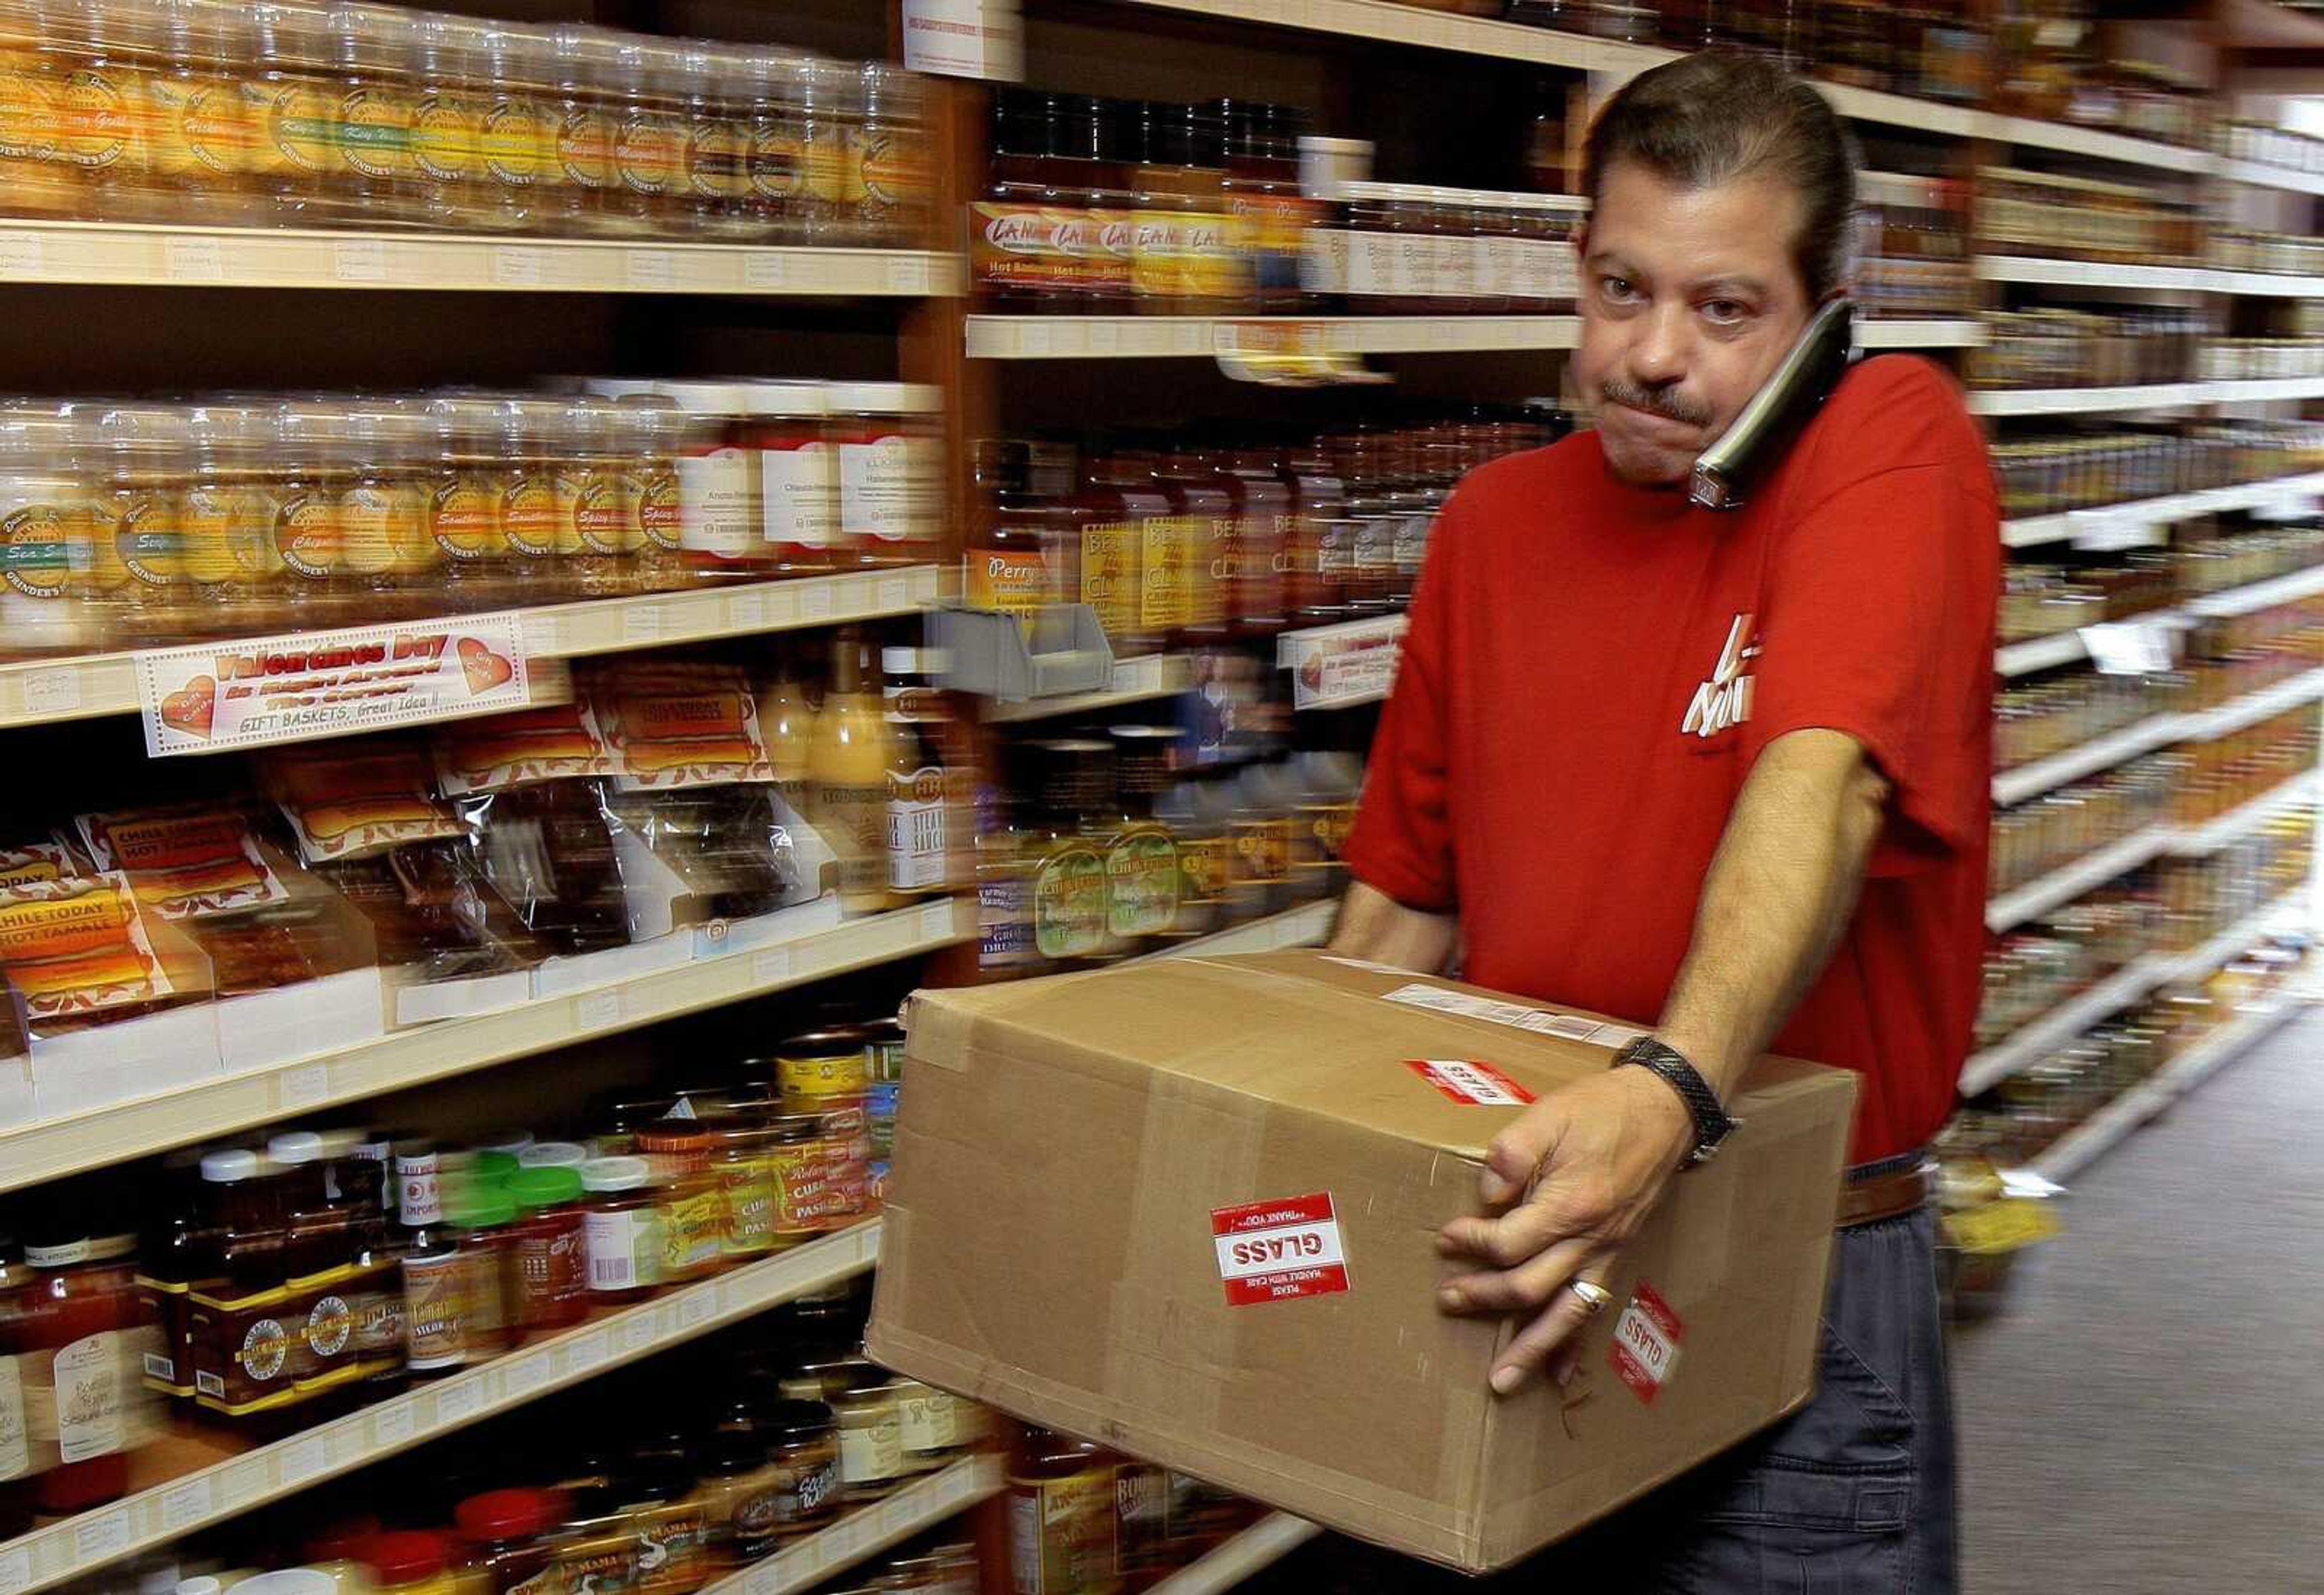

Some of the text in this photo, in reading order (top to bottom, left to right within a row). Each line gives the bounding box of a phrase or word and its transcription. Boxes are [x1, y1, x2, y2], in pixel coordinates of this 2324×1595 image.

[393, 634, 449, 662] Day
[240, 714, 278, 733] GIFT
[283, 705, 350, 728] BASKETS,
[357, 699, 392, 717] Great
[398, 695, 427, 712] Idea
[0, 873, 44, 889] ODAY
[48, 902, 104, 921] TODAY
[0, 920, 116, 945] HOT TAMALE
[1444, 1064, 1502, 1100] GLASS
[1232, 1232, 1324, 1265] GLASS
[1246, 1269, 1322, 1288] HANDLE WITH CARE
[1272, 1284, 1300, 1296] PLEASE
[1625, 1315, 1662, 1366] GLASS
